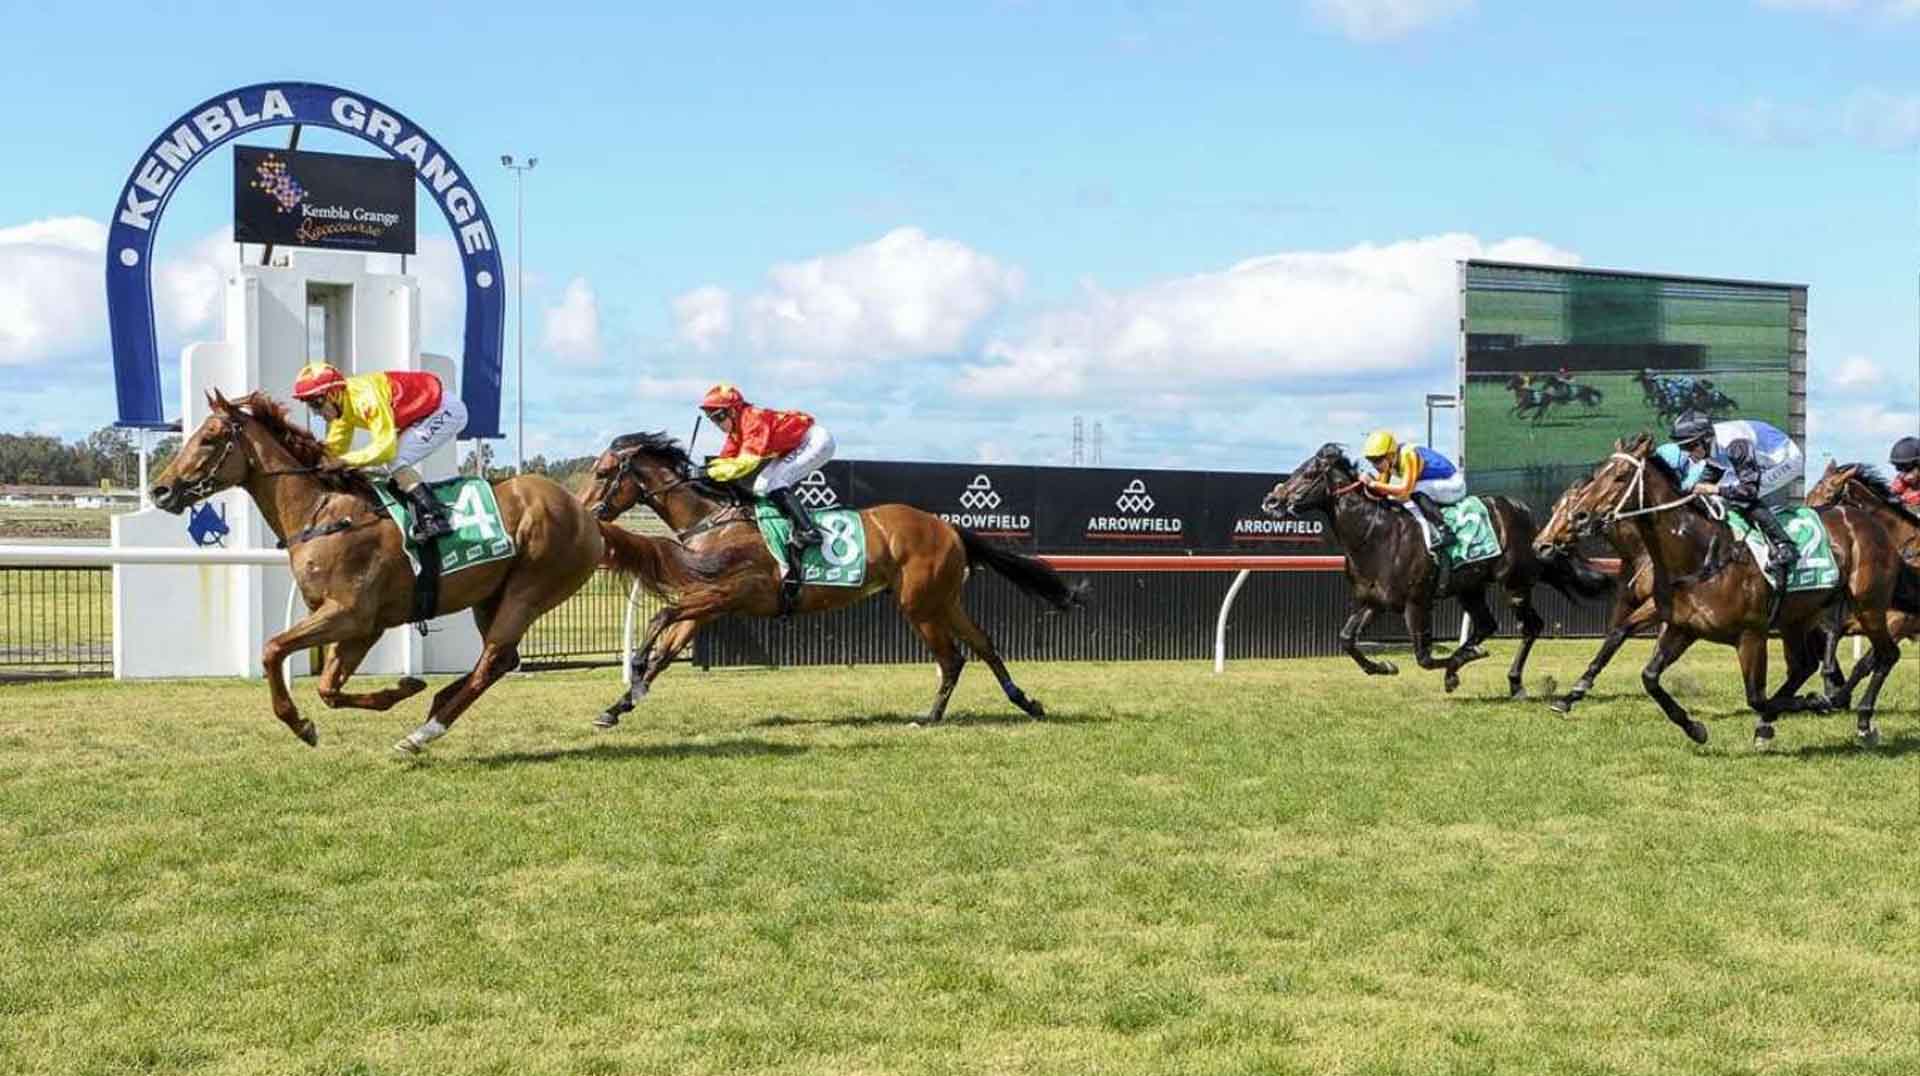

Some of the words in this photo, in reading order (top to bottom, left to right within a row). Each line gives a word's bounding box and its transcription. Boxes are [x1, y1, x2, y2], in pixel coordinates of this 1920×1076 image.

[120, 90, 295, 230] KEMBLA
[331, 97, 492, 254] GRANGE
[302, 204, 350, 219] Kembla
[353, 208, 399, 226] Grange
[448, 484, 497, 540] 4
[938, 513, 1030, 528] RROWFIELD
[1087, 517, 1182, 532] ARROWFIELD
[1233, 520, 1323, 534] ARROWFIELD
[821, 510, 858, 567] 8
[1784, 517, 1832, 570] 2
